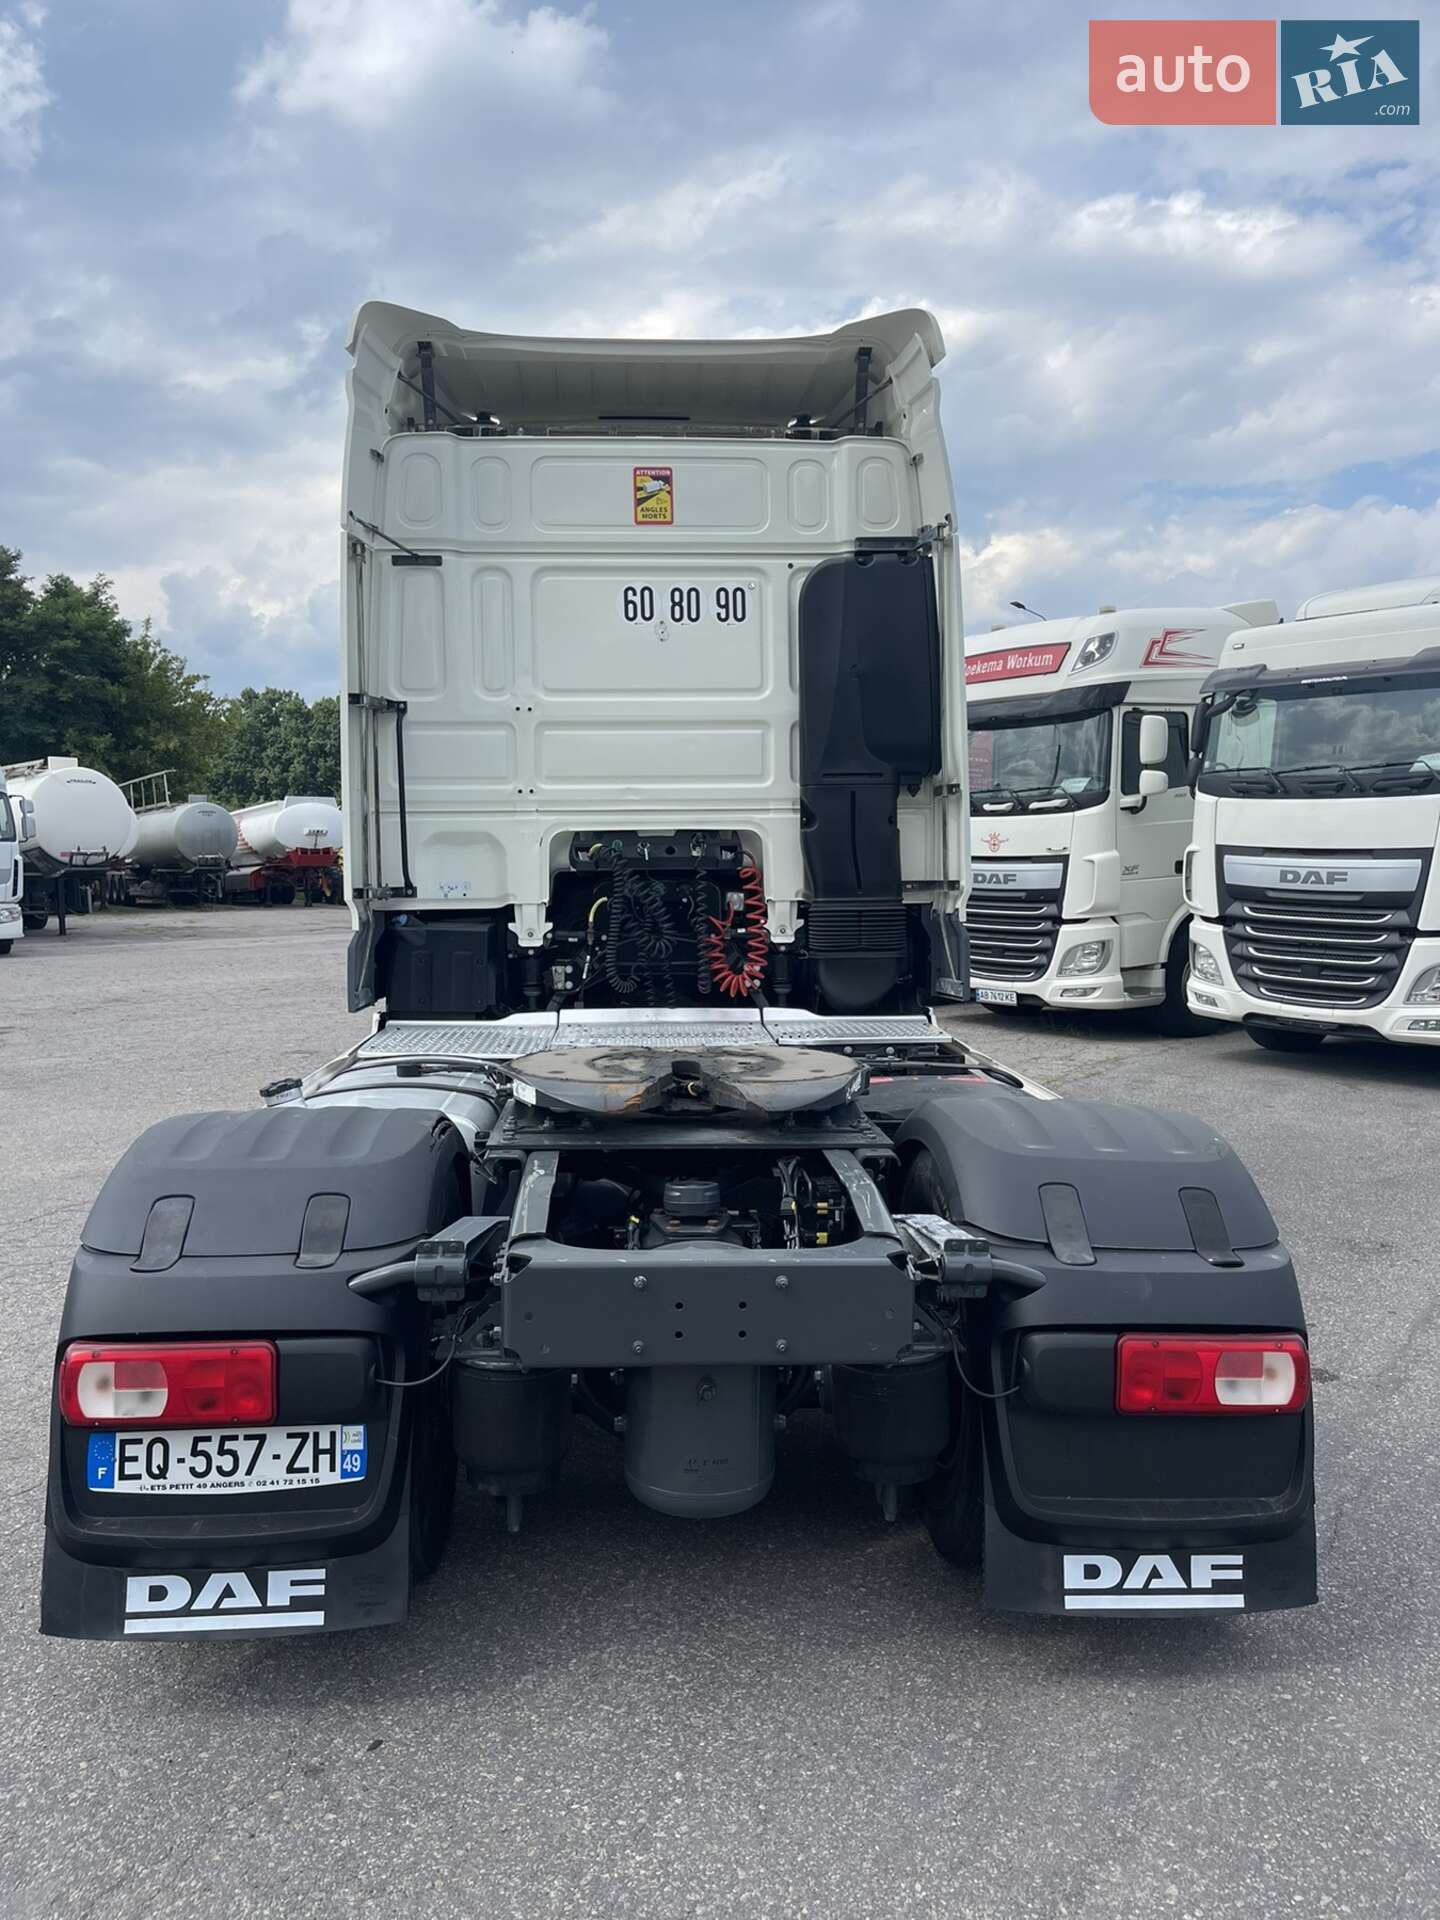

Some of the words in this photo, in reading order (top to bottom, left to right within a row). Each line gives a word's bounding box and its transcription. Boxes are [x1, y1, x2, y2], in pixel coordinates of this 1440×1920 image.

[623, 586, 654, 622] 60
[670, 587, 701, 623] 80
[716, 587, 746, 623] 90
[1007, 652, 1054, 670] Workum
[973, 872, 1017, 885] DAF
[1280, 869, 1349, 885] DAF
[118, 1430, 337, 1481] EQ-557-ZH
[342, 1453, 361, 1472] 49
[98, 1467, 107, 1480] F
[210, 1481, 245, 1489] ANGERS
[1063, 1554, 1243, 1589] DAF
[125, 1568, 326, 1613] DAF
